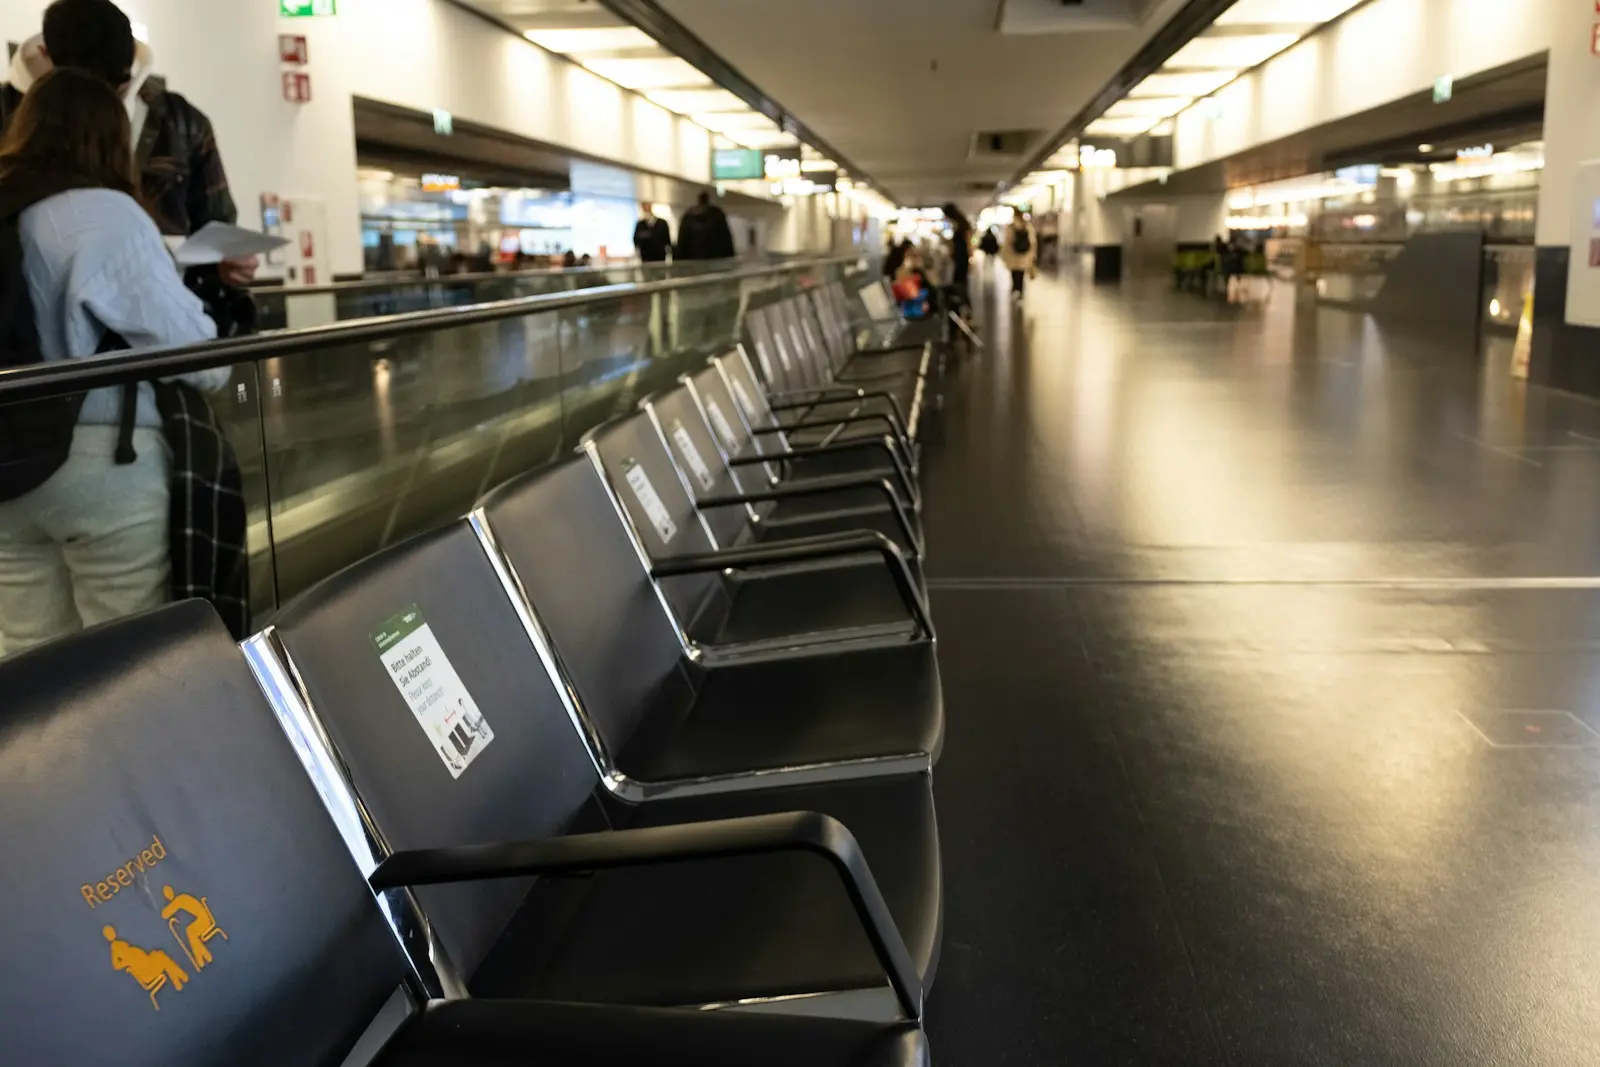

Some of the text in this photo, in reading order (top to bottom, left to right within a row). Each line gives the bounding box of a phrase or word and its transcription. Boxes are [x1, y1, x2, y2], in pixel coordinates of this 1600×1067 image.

[390, 646, 423, 673] Bitte halten
[399, 675, 410, 687] Sie
[80, 834, 166, 908] Reserved
